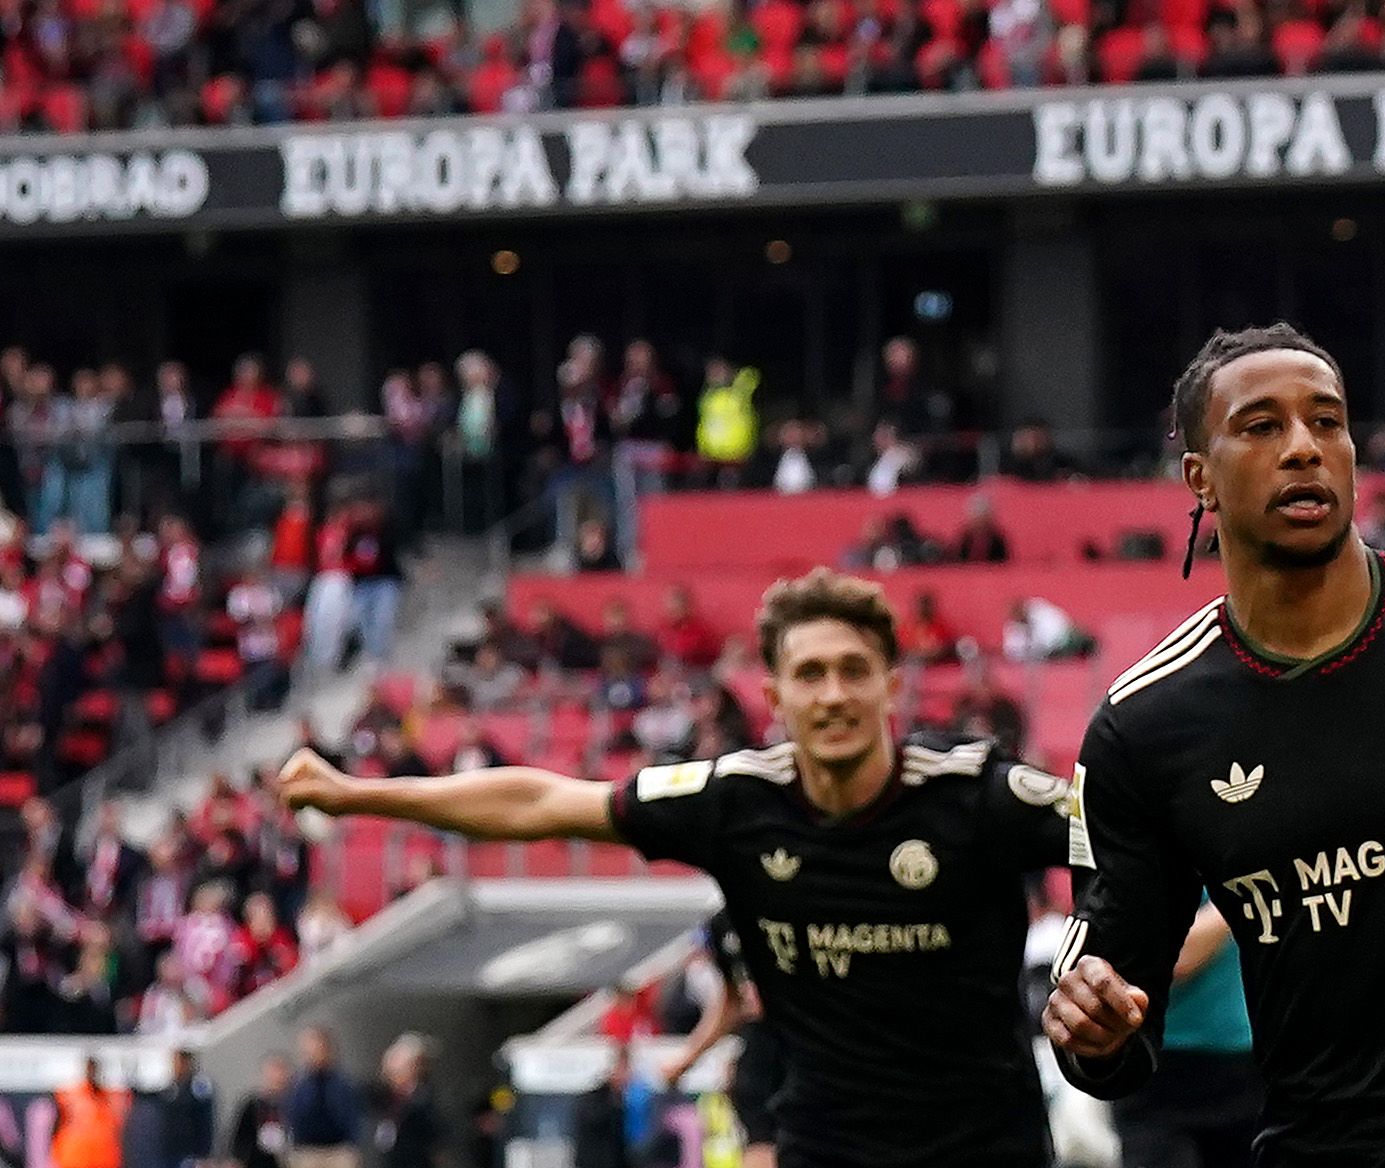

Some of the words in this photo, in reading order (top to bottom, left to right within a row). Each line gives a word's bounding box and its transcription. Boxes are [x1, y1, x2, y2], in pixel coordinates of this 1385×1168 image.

[281, 121, 560, 218] EUROPA
[566, 113, 759, 204] PARK
[1034, 92, 1351, 186] EUROPA
[0, 153, 208, 224] OBRAD
[807, 922, 950, 954] MAGENTA
[1302, 889, 1352, 932] TV
[811, 951, 850, 978] TV
